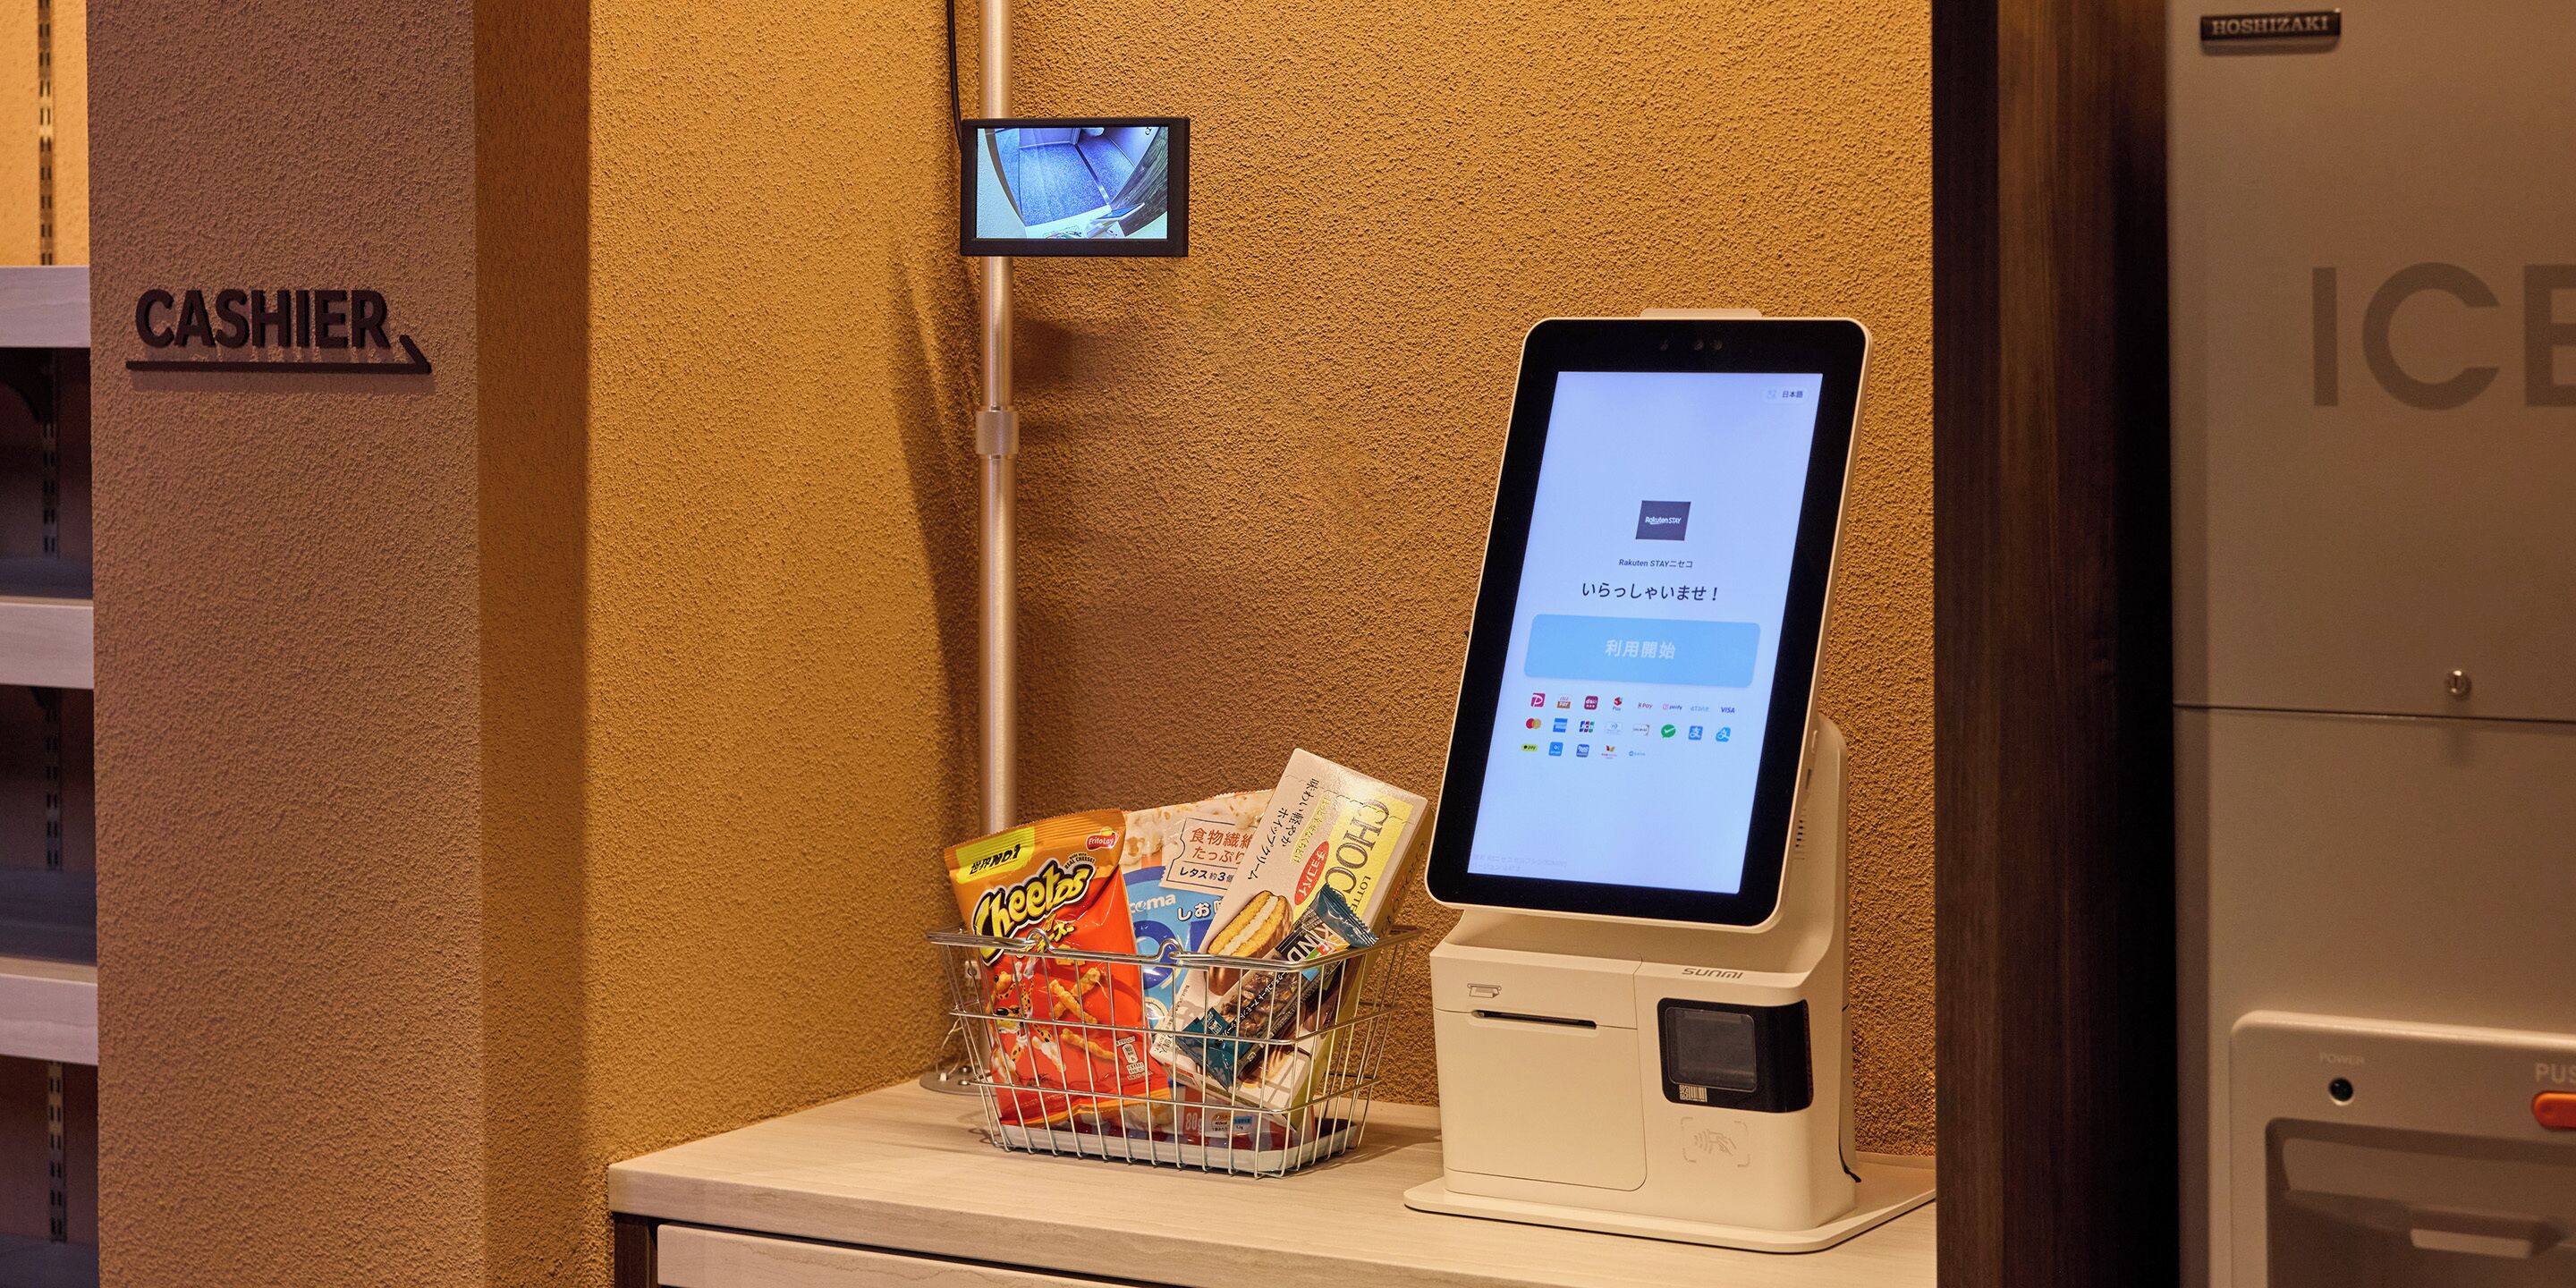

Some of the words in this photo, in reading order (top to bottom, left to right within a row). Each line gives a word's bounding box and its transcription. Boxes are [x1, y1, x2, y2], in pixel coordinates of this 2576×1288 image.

[2211, 16, 2329, 35] HOSHIZAKI
[134, 288, 390, 349] CASHIER
[2312, 262, 2576, 409] ICE
[1782, 390, 1803, 399] 日本語
[1645, 516, 1668, 525] Rakuten
[1618, 558, 1648, 567] Rakuten
[1649, 559, 1693, 569] STAYニセコ
[1582, 582, 1718, 602] いらっしゃいませ！
[1605, 639, 1676, 659] 利用開始
[1282, 777, 1319, 847] 味わい軽やか
[1247, 807, 1289, 880] ホイップクリーム
[1325, 798, 1390, 902] CHOC
[1298, 849, 1328, 899] チョコパイ
[1286, 923, 1337, 963] KIND
[2319, 1052, 2366, 1066] POWER
